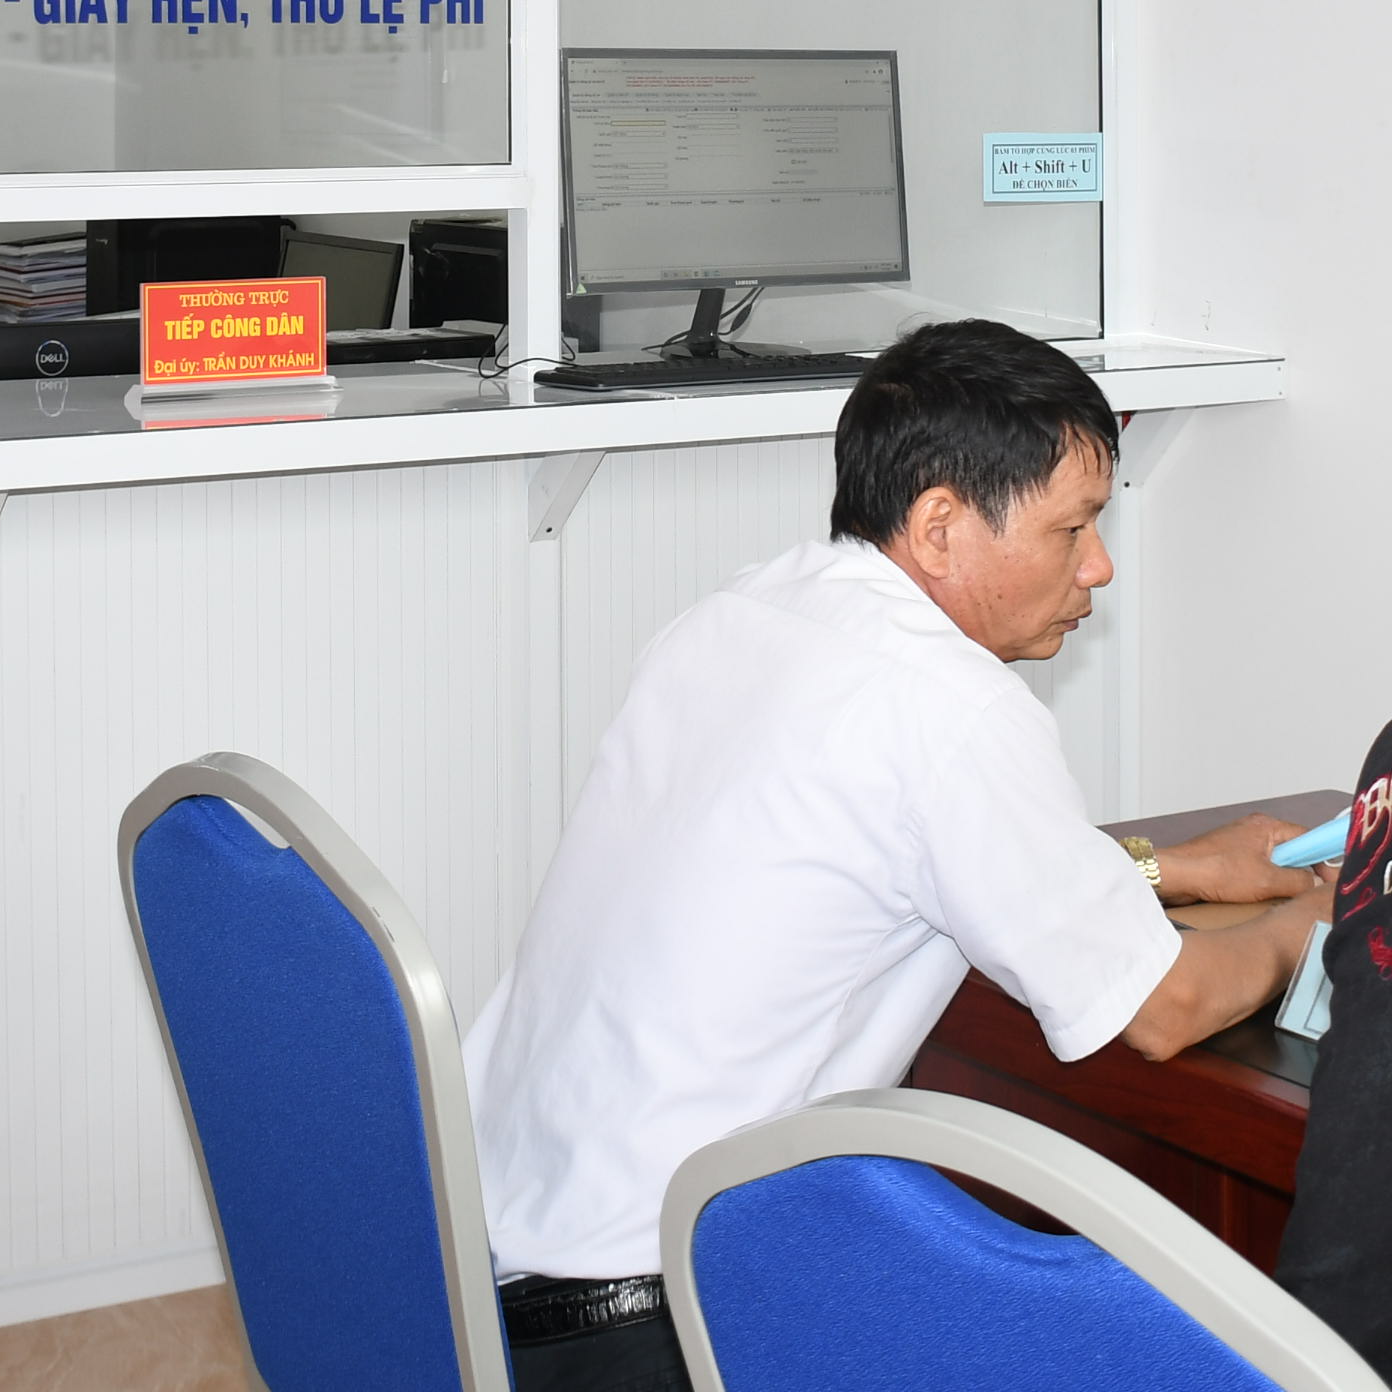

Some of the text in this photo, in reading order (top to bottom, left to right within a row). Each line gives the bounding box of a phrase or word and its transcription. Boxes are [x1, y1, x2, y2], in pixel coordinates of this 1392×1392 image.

[998, 160, 1018, 175] Alt
[1034, 159, 1065, 174] Shift
[1082, 159, 1092, 174] U
[179, 289, 289, 308] THƯỜNG TRỰC
[164, 312, 304, 340] TIẾP CÔNG DÂN
[40, 353, 66, 364] DELL
[154, 360, 177, 377] Đại
[239, 355, 267, 370] DUY
[269, 350, 315, 368] KHÁNH
